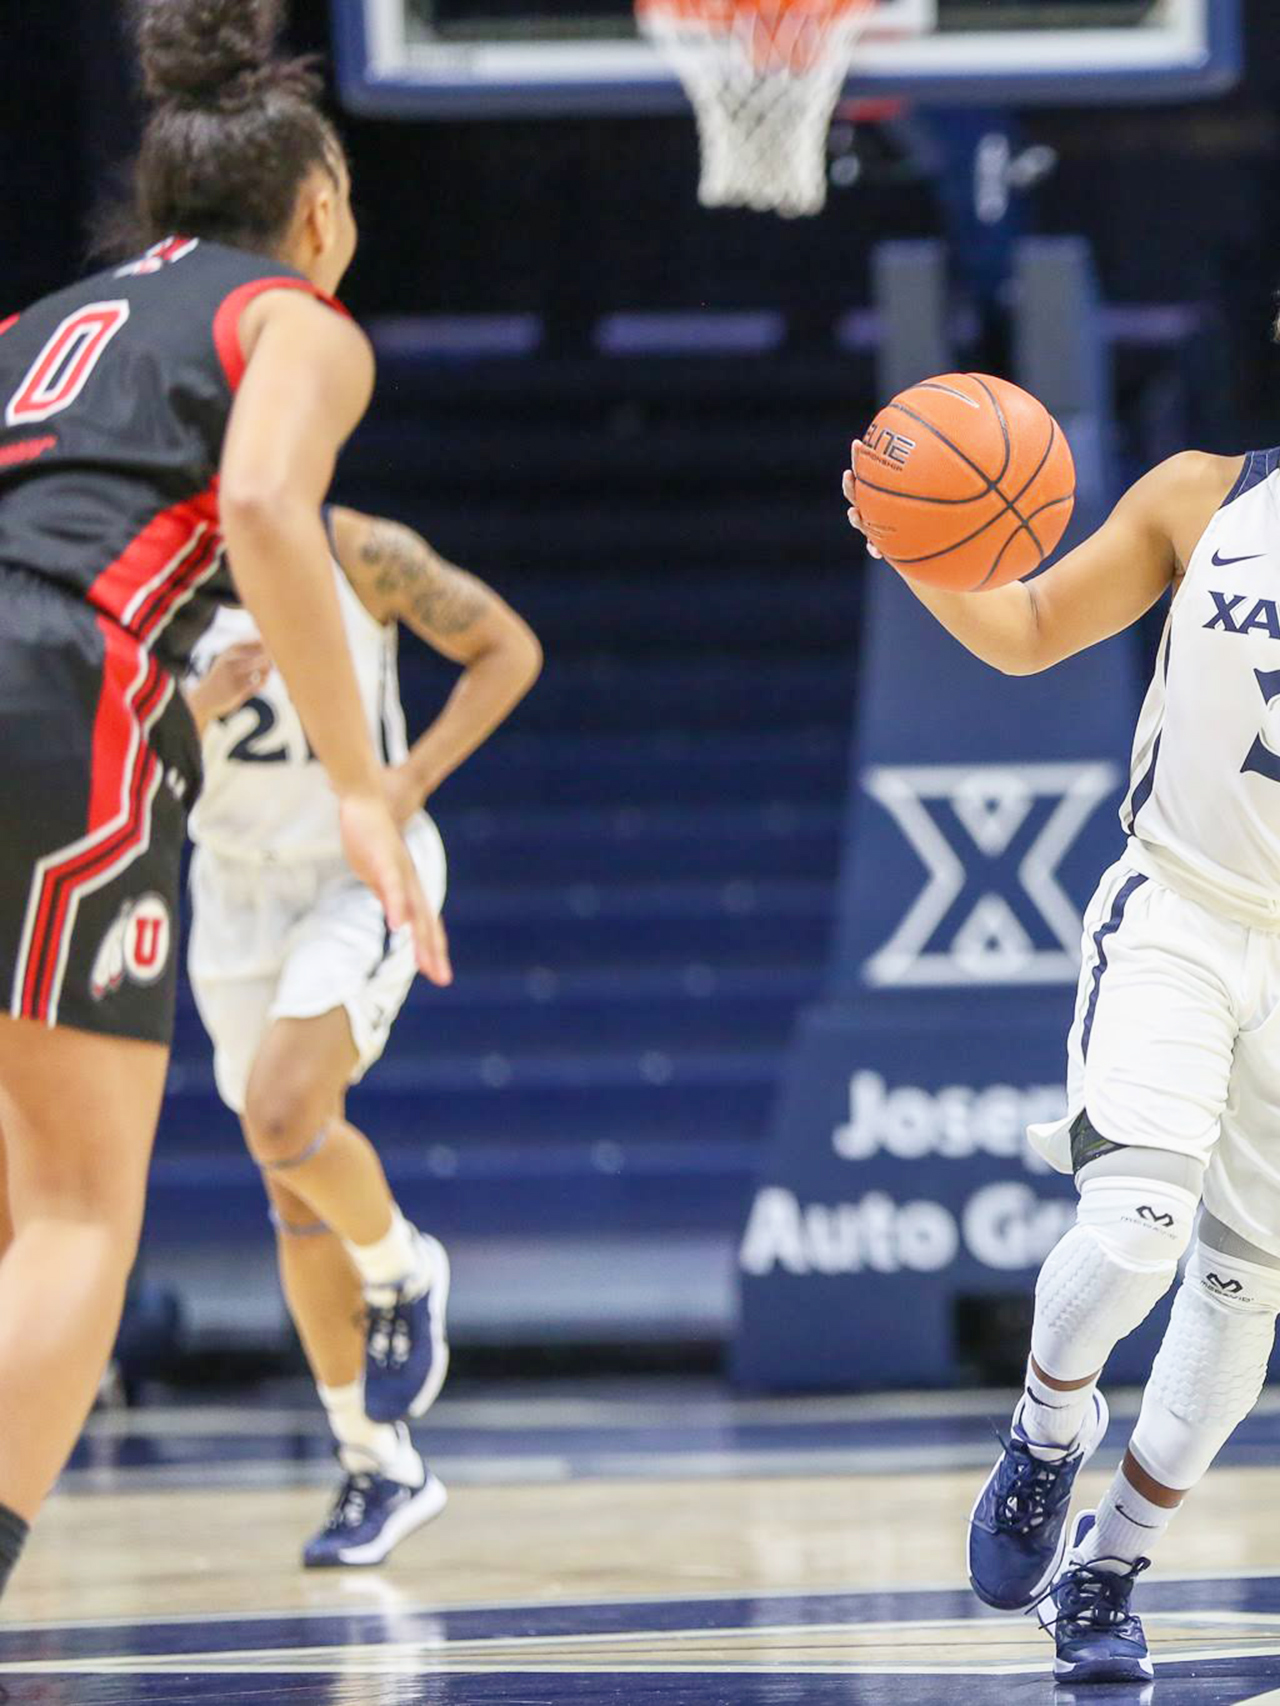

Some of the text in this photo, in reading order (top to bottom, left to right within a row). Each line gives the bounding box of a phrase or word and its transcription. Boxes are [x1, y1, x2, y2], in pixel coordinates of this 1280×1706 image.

[219, 697, 318, 762] 2
[134, 918, 162, 968] U
[833, 1070, 1068, 1172] Josep
[739, 1186, 958, 1274] Auto
